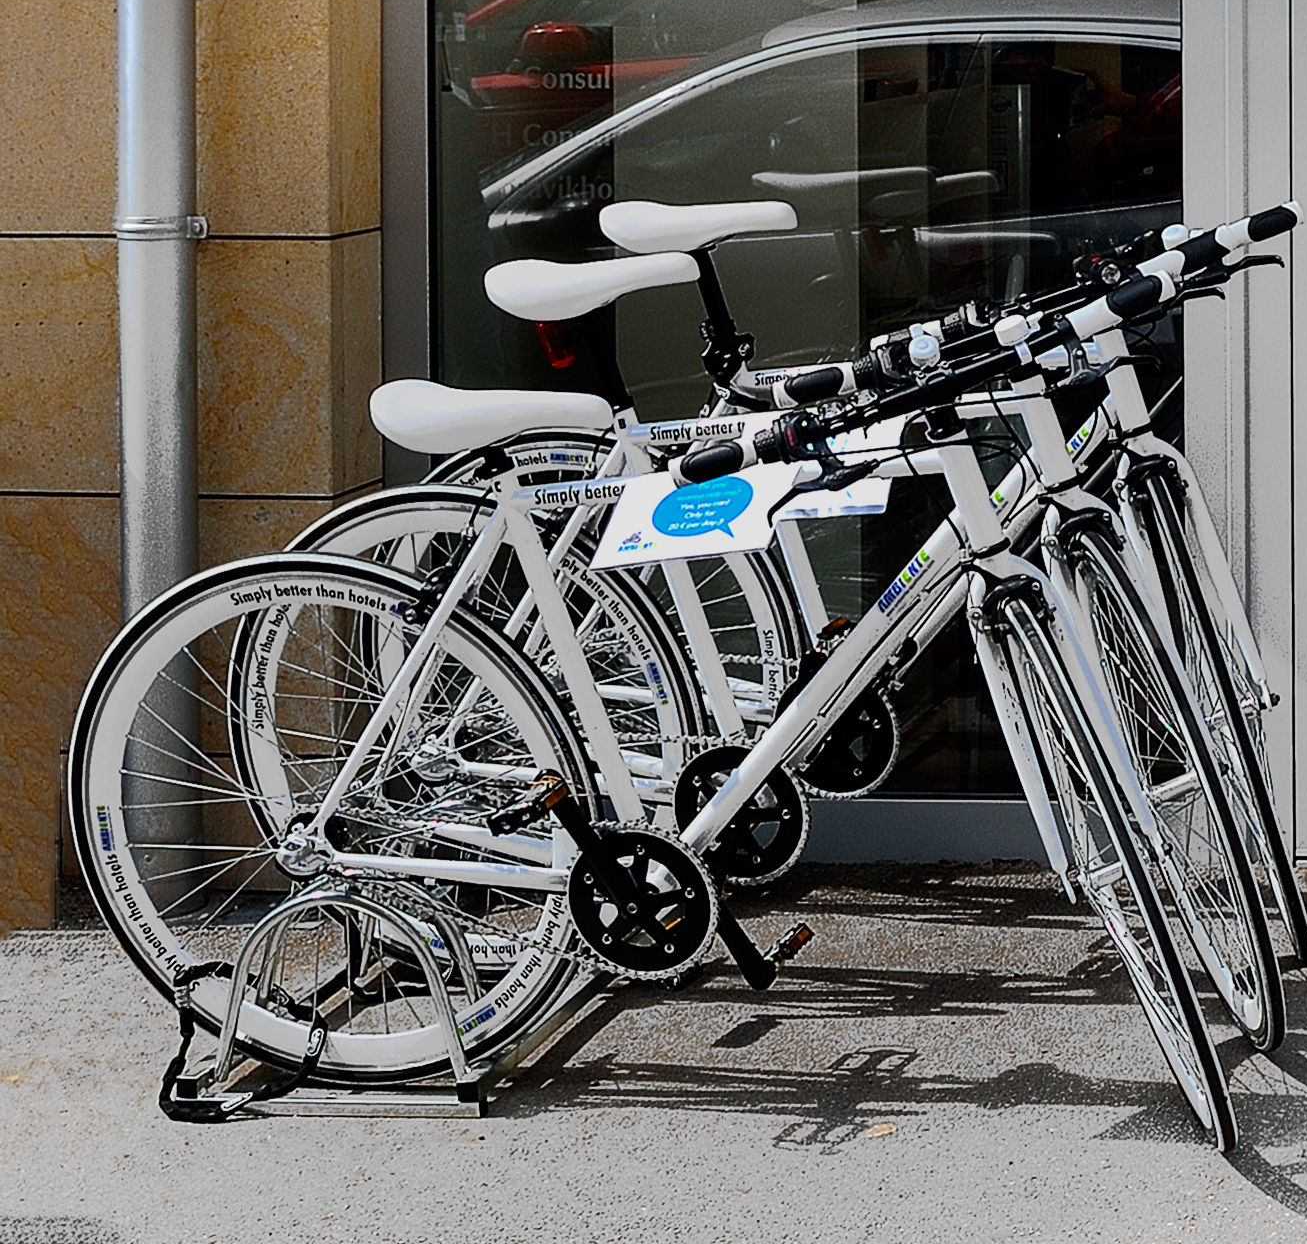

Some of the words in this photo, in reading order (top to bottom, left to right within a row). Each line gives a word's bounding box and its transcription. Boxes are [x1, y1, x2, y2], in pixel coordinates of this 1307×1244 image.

[618, 418, 627, 429] B
[650, 422, 691, 441] Simply
[696, 421, 733, 437] better
[515, 452, 548, 467] hotels
[534, 485, 580, 505] Simply
[877, 549, 930, 613] AMBIENTE
[230, 585, 272, 606] Simply
[274, 584, 312, 597] better
[316, 584, 344, 600] than
[349, 589, 387, 611] hotels
[580, 570, 609, 601] better
[608, 600, 629, 625] than
[627, 625, 652, 661] hotels
[259, 630, 278, 653] than
[105, 854, 128, 892] hotels
[123, 893, 143, 921] than
[139, 922, 167, 958] better
[522, 954, 542, 978] than
[494, 980, 526, 1008] hotels
